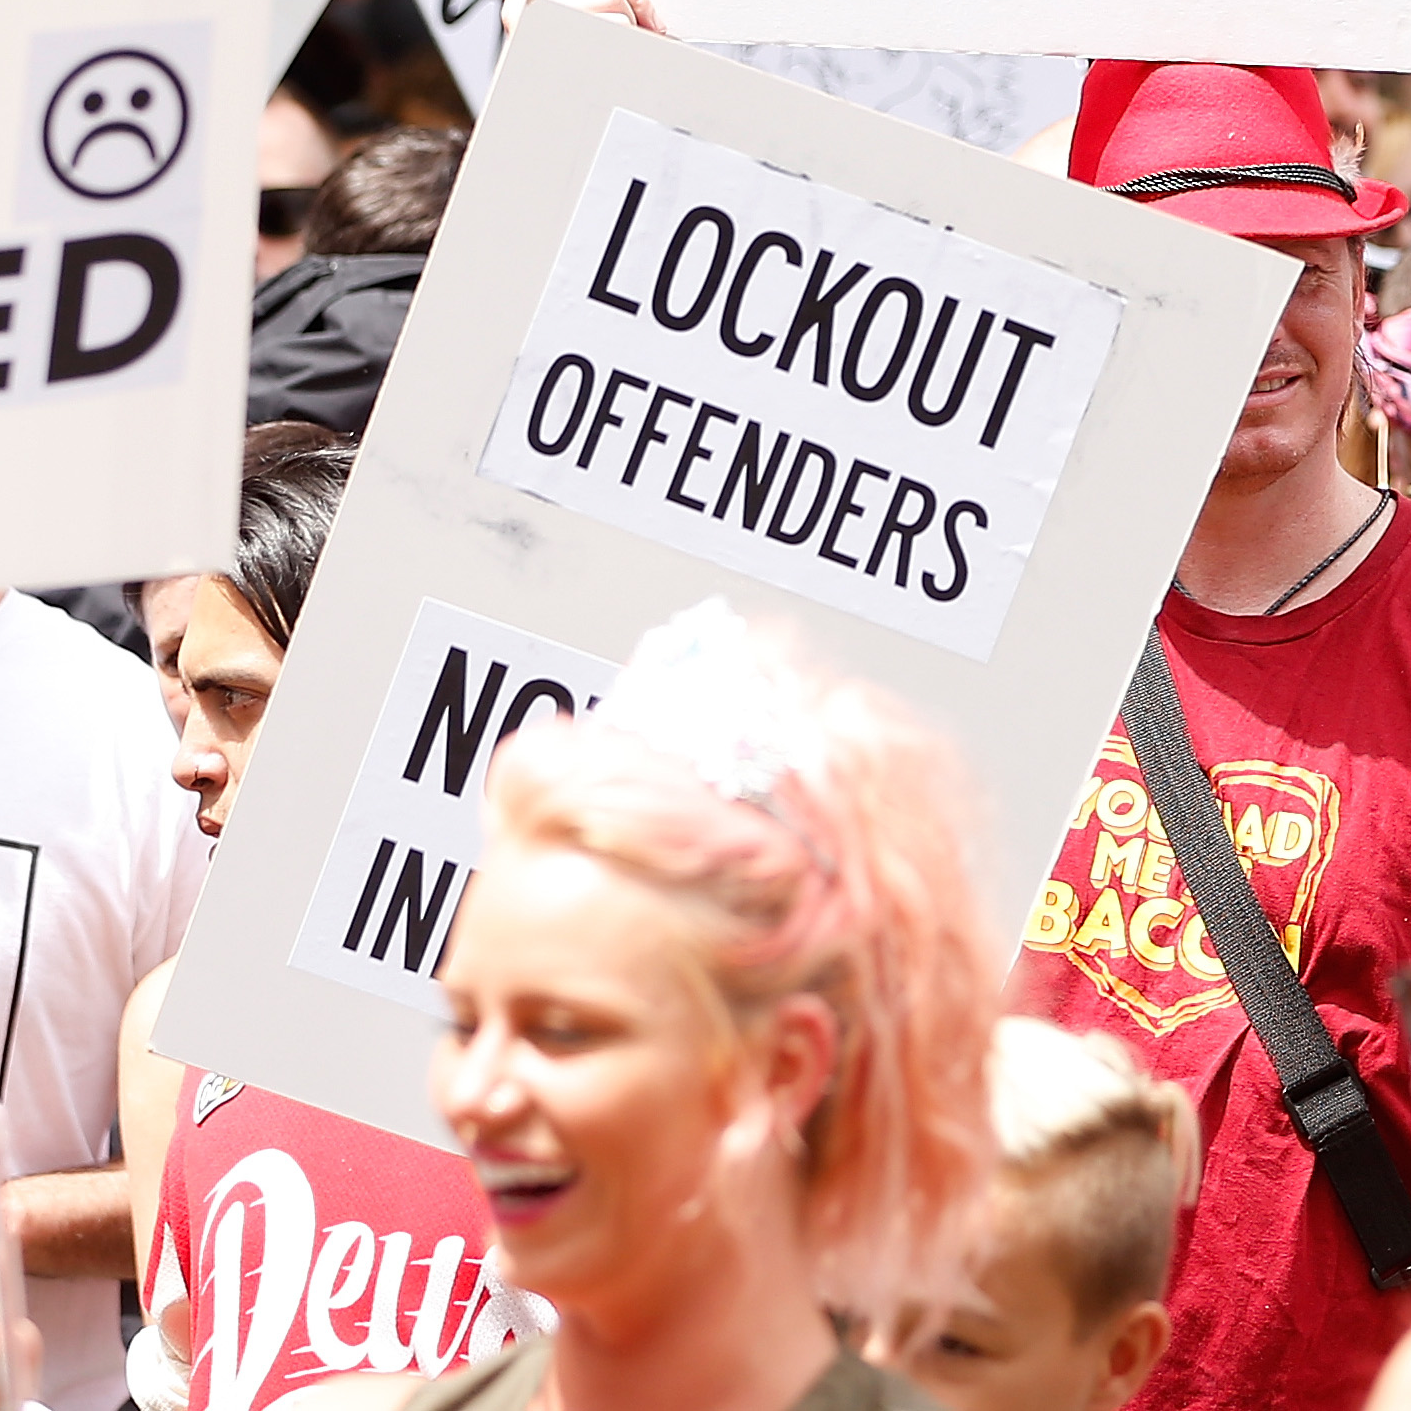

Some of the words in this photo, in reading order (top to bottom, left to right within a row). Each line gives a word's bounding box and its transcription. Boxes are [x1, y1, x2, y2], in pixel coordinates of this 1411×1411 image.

[587, 178, 1055, 450] LOCKOUT
[526, 352, 989, 603] OFFENDERS
[342, 837, 479, 980] IN
[1089, 831, 1176, 898] ME
